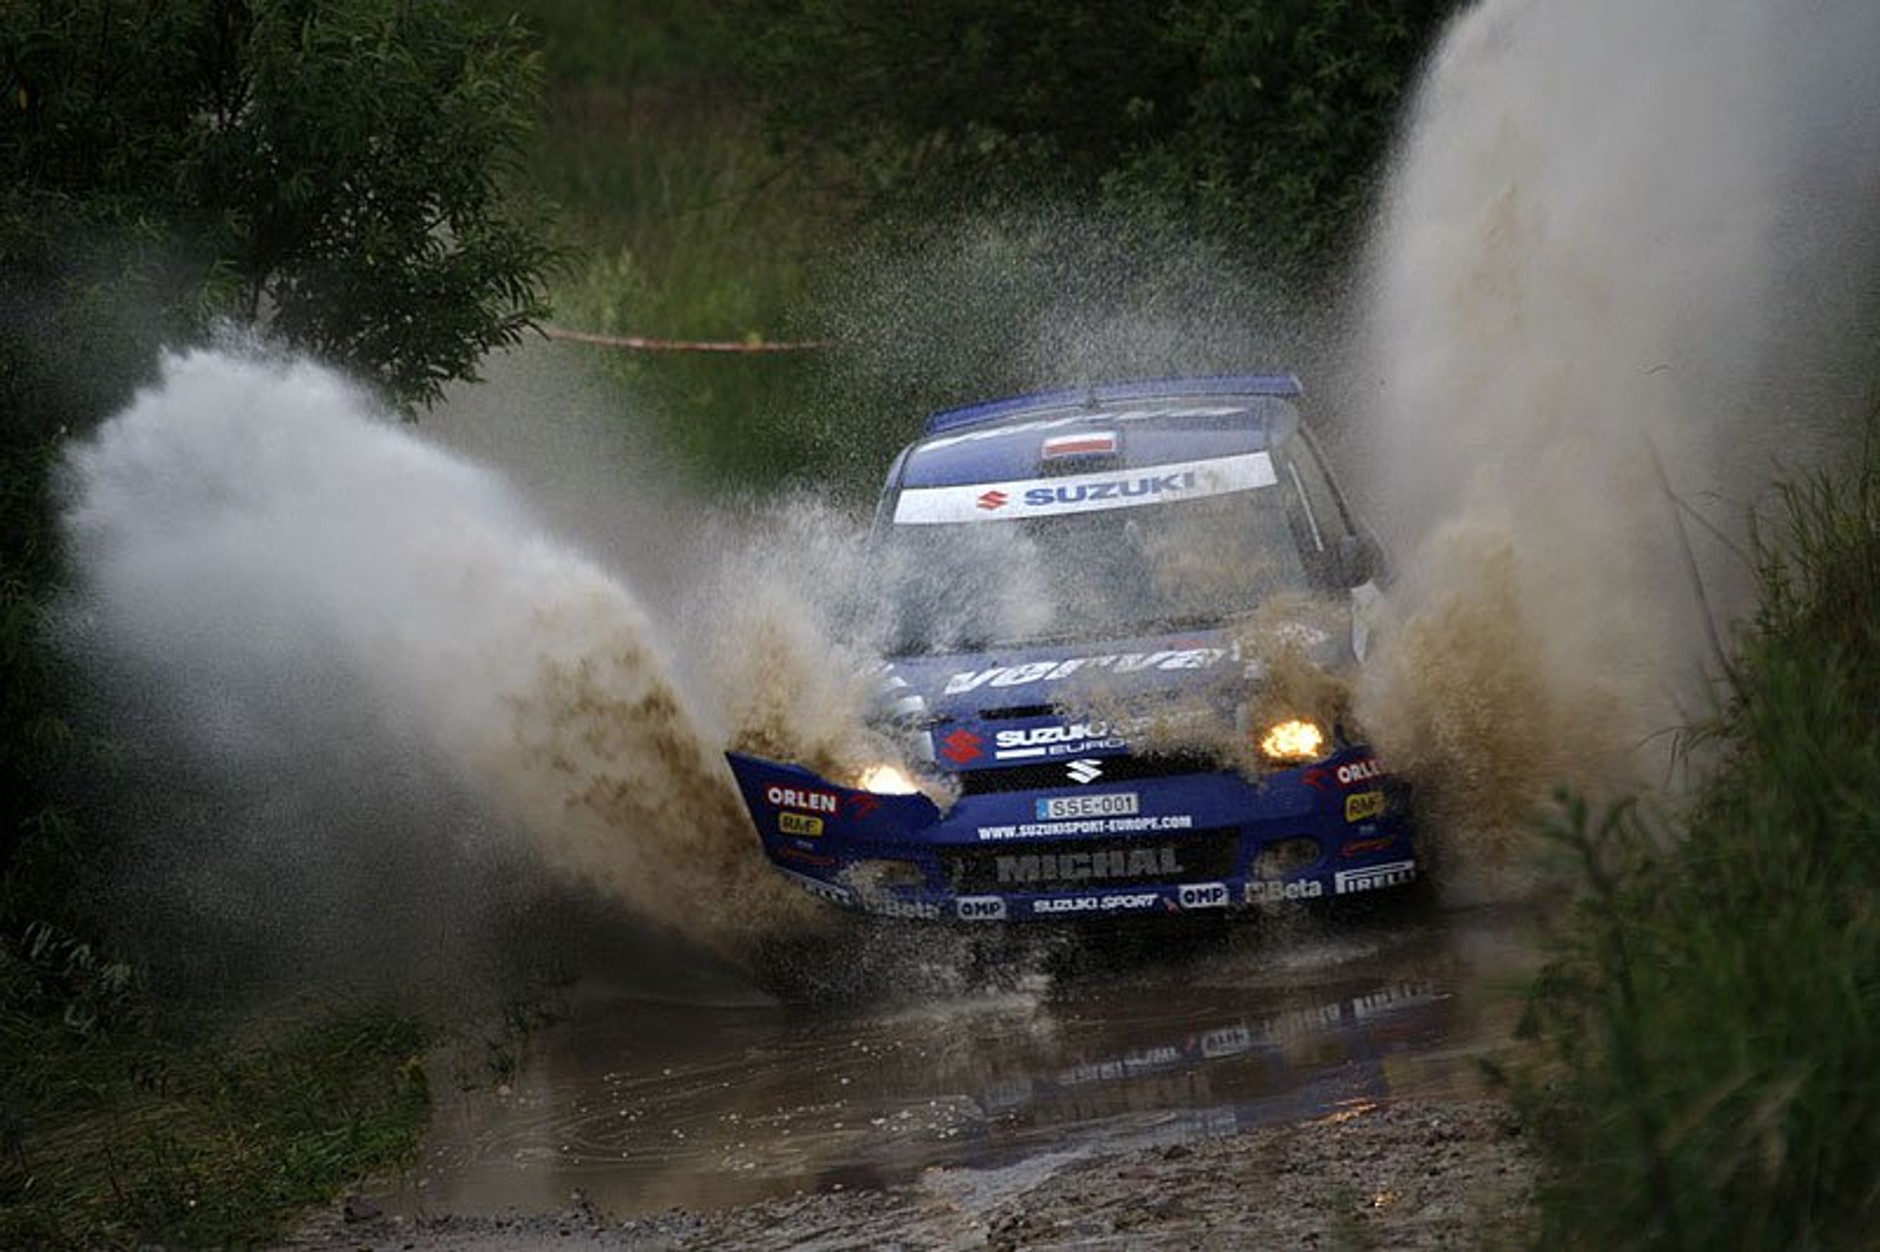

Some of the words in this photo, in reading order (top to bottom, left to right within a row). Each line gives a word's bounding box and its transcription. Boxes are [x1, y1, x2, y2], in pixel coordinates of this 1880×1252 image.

[1024, 472, 1196, 506] SUZUKI
[1337, 761, 1381, 783] ORLE
[768, 787, 837, 812] ORLEN
[1052, 796, 1133, 817] SSE-001
[782, 815, 817, 833] RMF
[978, 816, 1193, 840] WWW.SUZUKISPORT-EUROPE.COM
[1335, 861, 1416, 894] PIRELLI
[1183, 888, 1224, 905] OMP
[1266, 878, 1322, 900] Beta
[961, 901, 1002, 917] OMP
[1034, 897, 1098, 913] SUZUKI
[1100, 894, 1159, 910] SPORT
